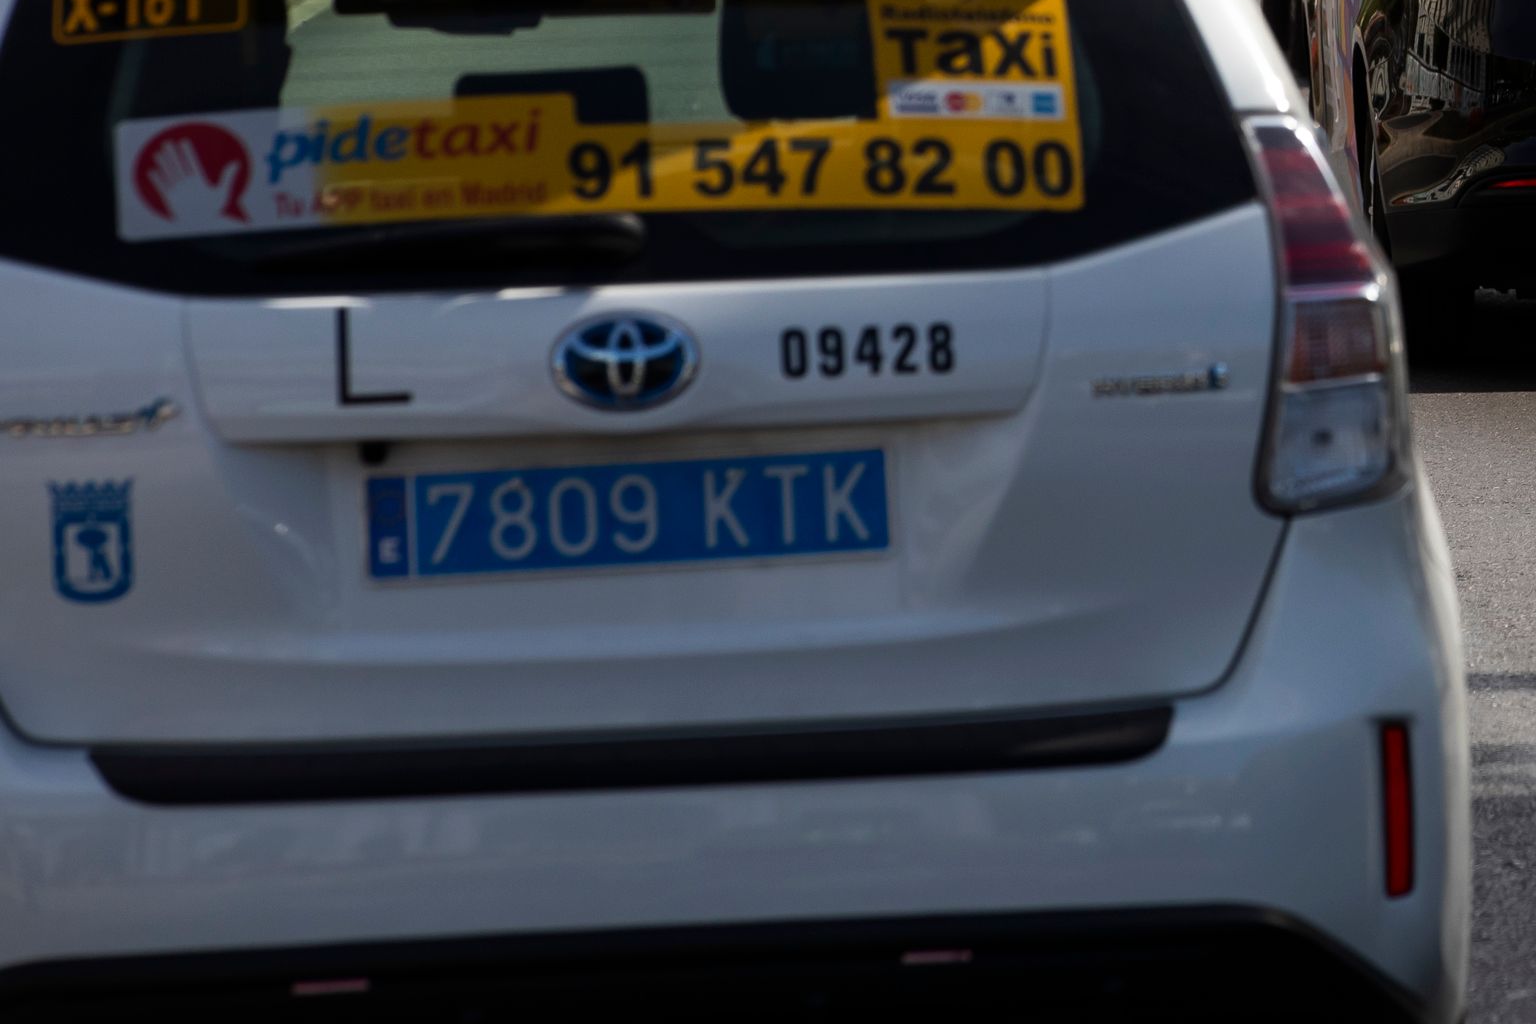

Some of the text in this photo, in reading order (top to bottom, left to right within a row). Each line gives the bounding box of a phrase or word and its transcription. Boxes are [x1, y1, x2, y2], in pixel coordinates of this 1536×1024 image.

[883, 28, 1059, 78] Taxi
[568, 137, 1074, 201] 91 547 82 00
[335, 307, 413, 407] L
[779, 321, 956, 379] 09428
[426, 462, 871, 564] 7809 KTK
